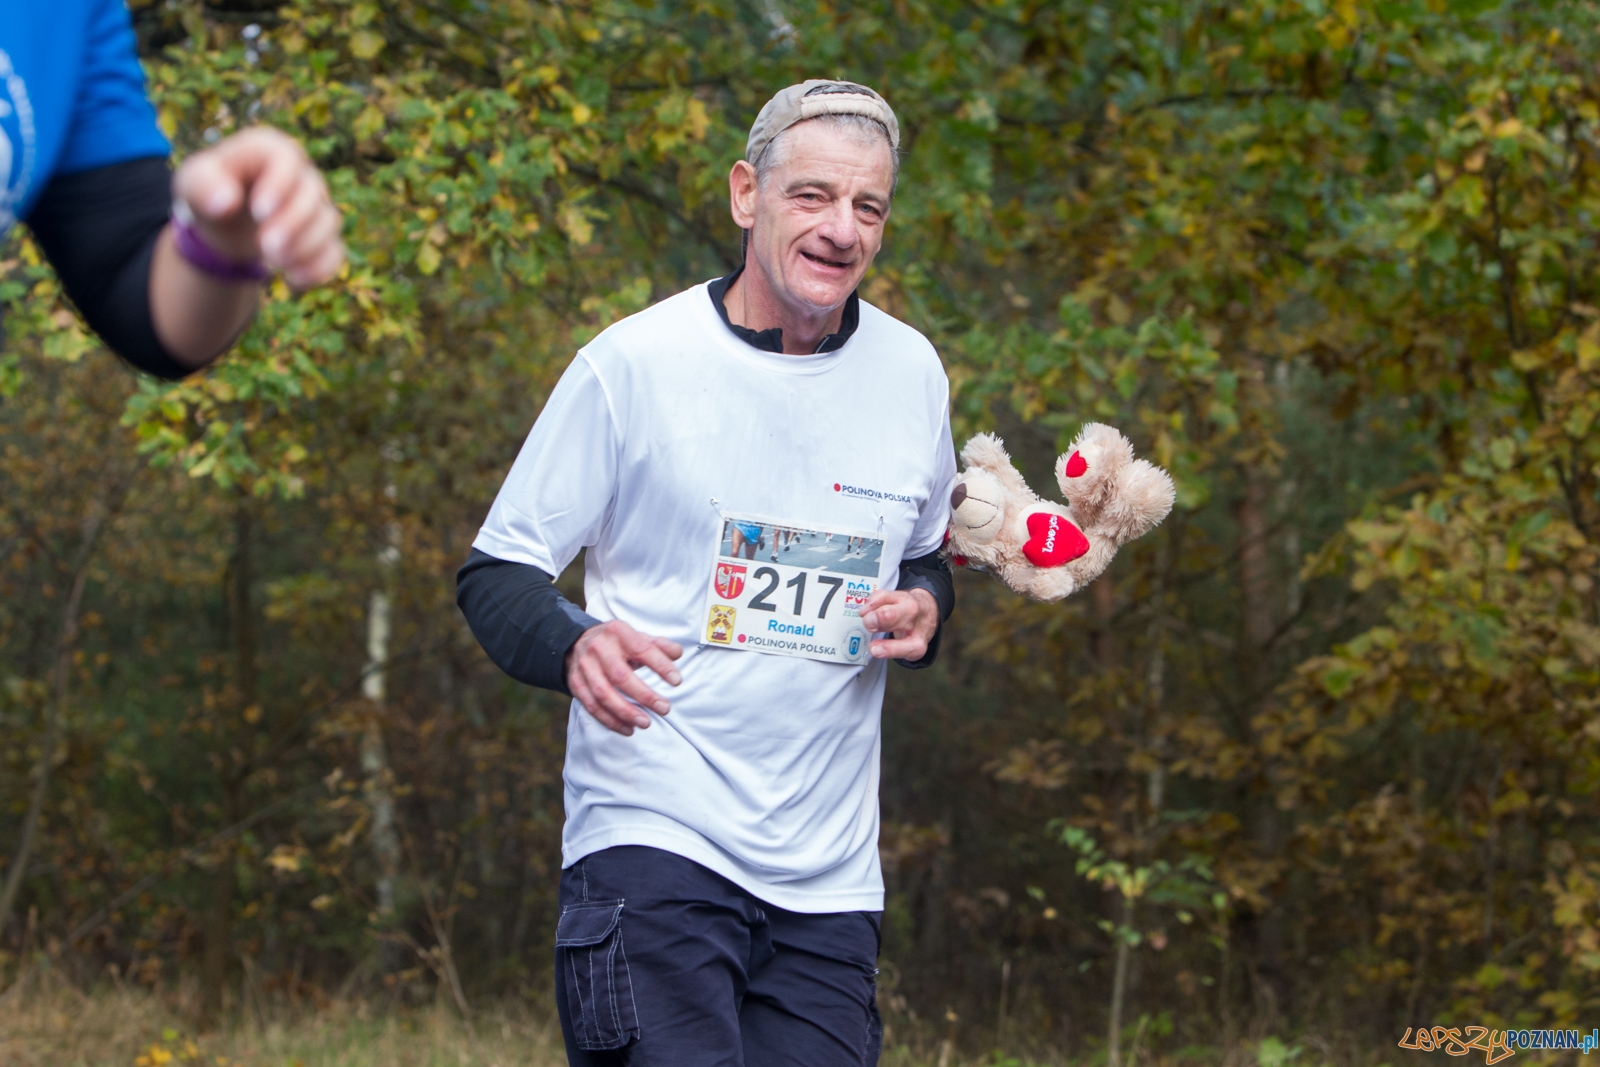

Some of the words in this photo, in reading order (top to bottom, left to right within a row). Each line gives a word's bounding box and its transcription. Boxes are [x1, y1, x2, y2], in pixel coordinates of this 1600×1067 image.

[842, 485, 883, 500] POLINOVA
[884, 492, 911, 503] POLSKA
[747, 566, 844, 619] 217
[767, 619, 815, 637] Ronald
[748, 636, 798, 650] POLINOVA
[800, 642, 836, 655] POLSKA
